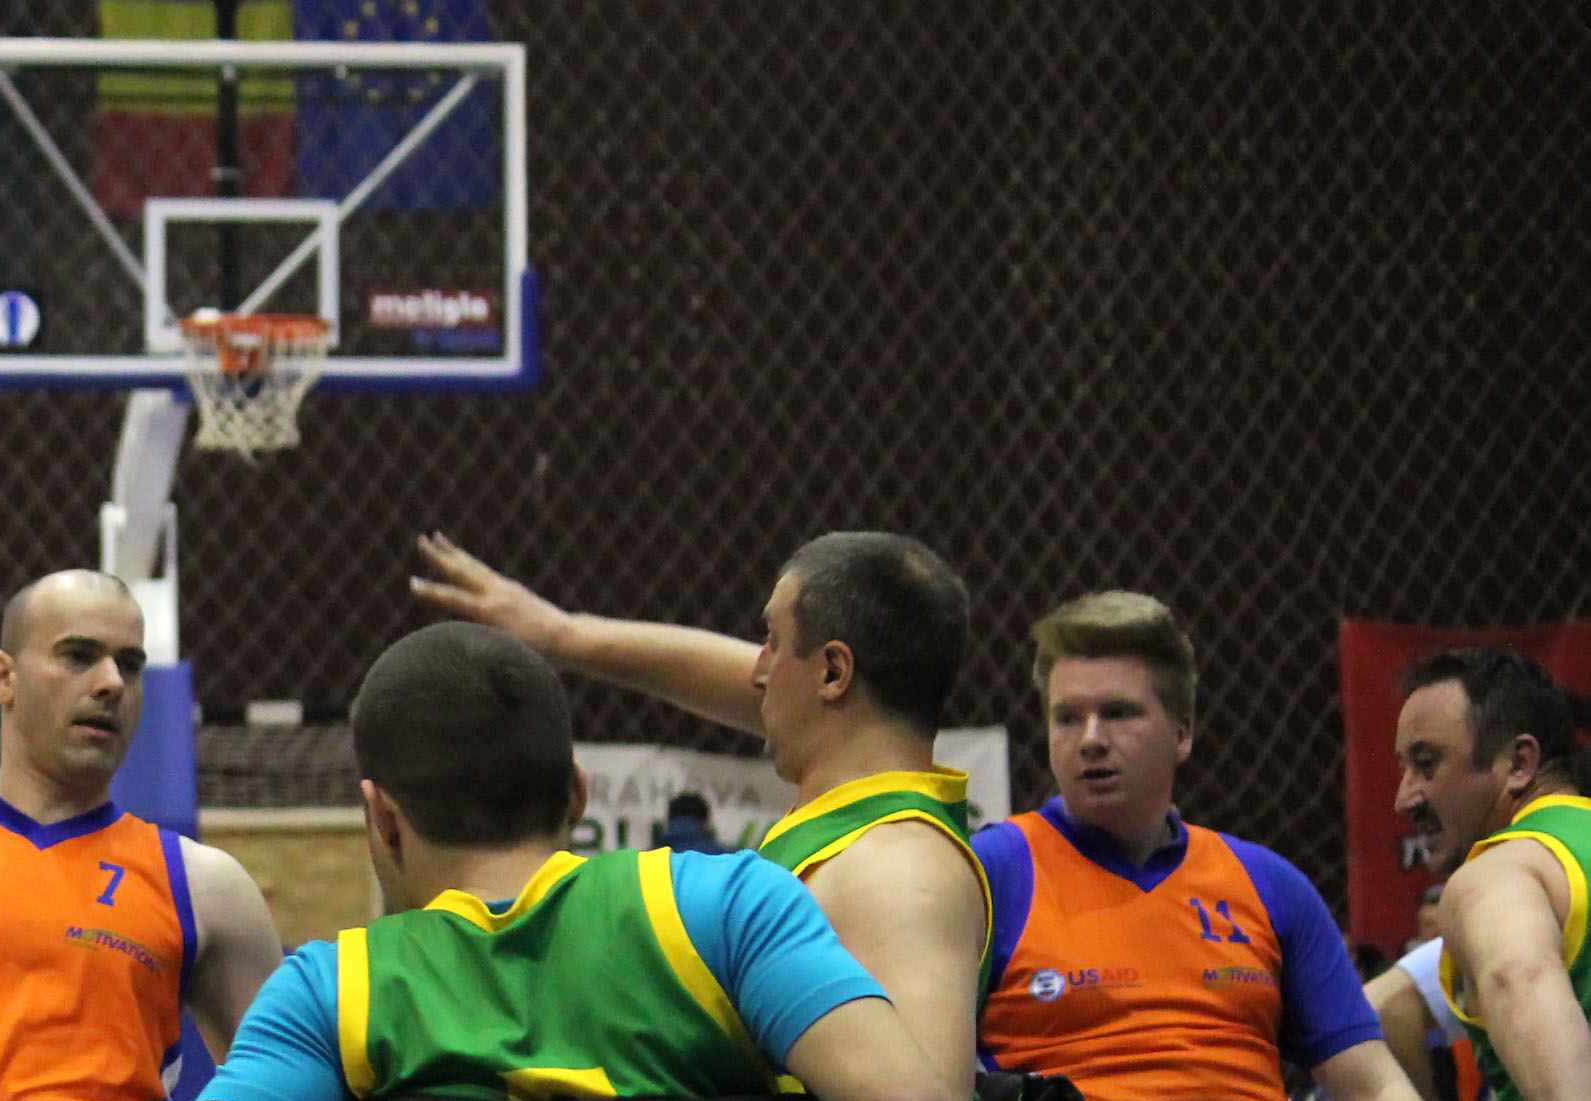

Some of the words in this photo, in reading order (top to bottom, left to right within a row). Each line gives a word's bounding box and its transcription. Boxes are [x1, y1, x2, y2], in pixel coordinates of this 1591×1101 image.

[97, 861, 126, 907] 7
[66, 926, 155, 972] MOTIVATION
[1068, 968, 1139, 986] USAID
